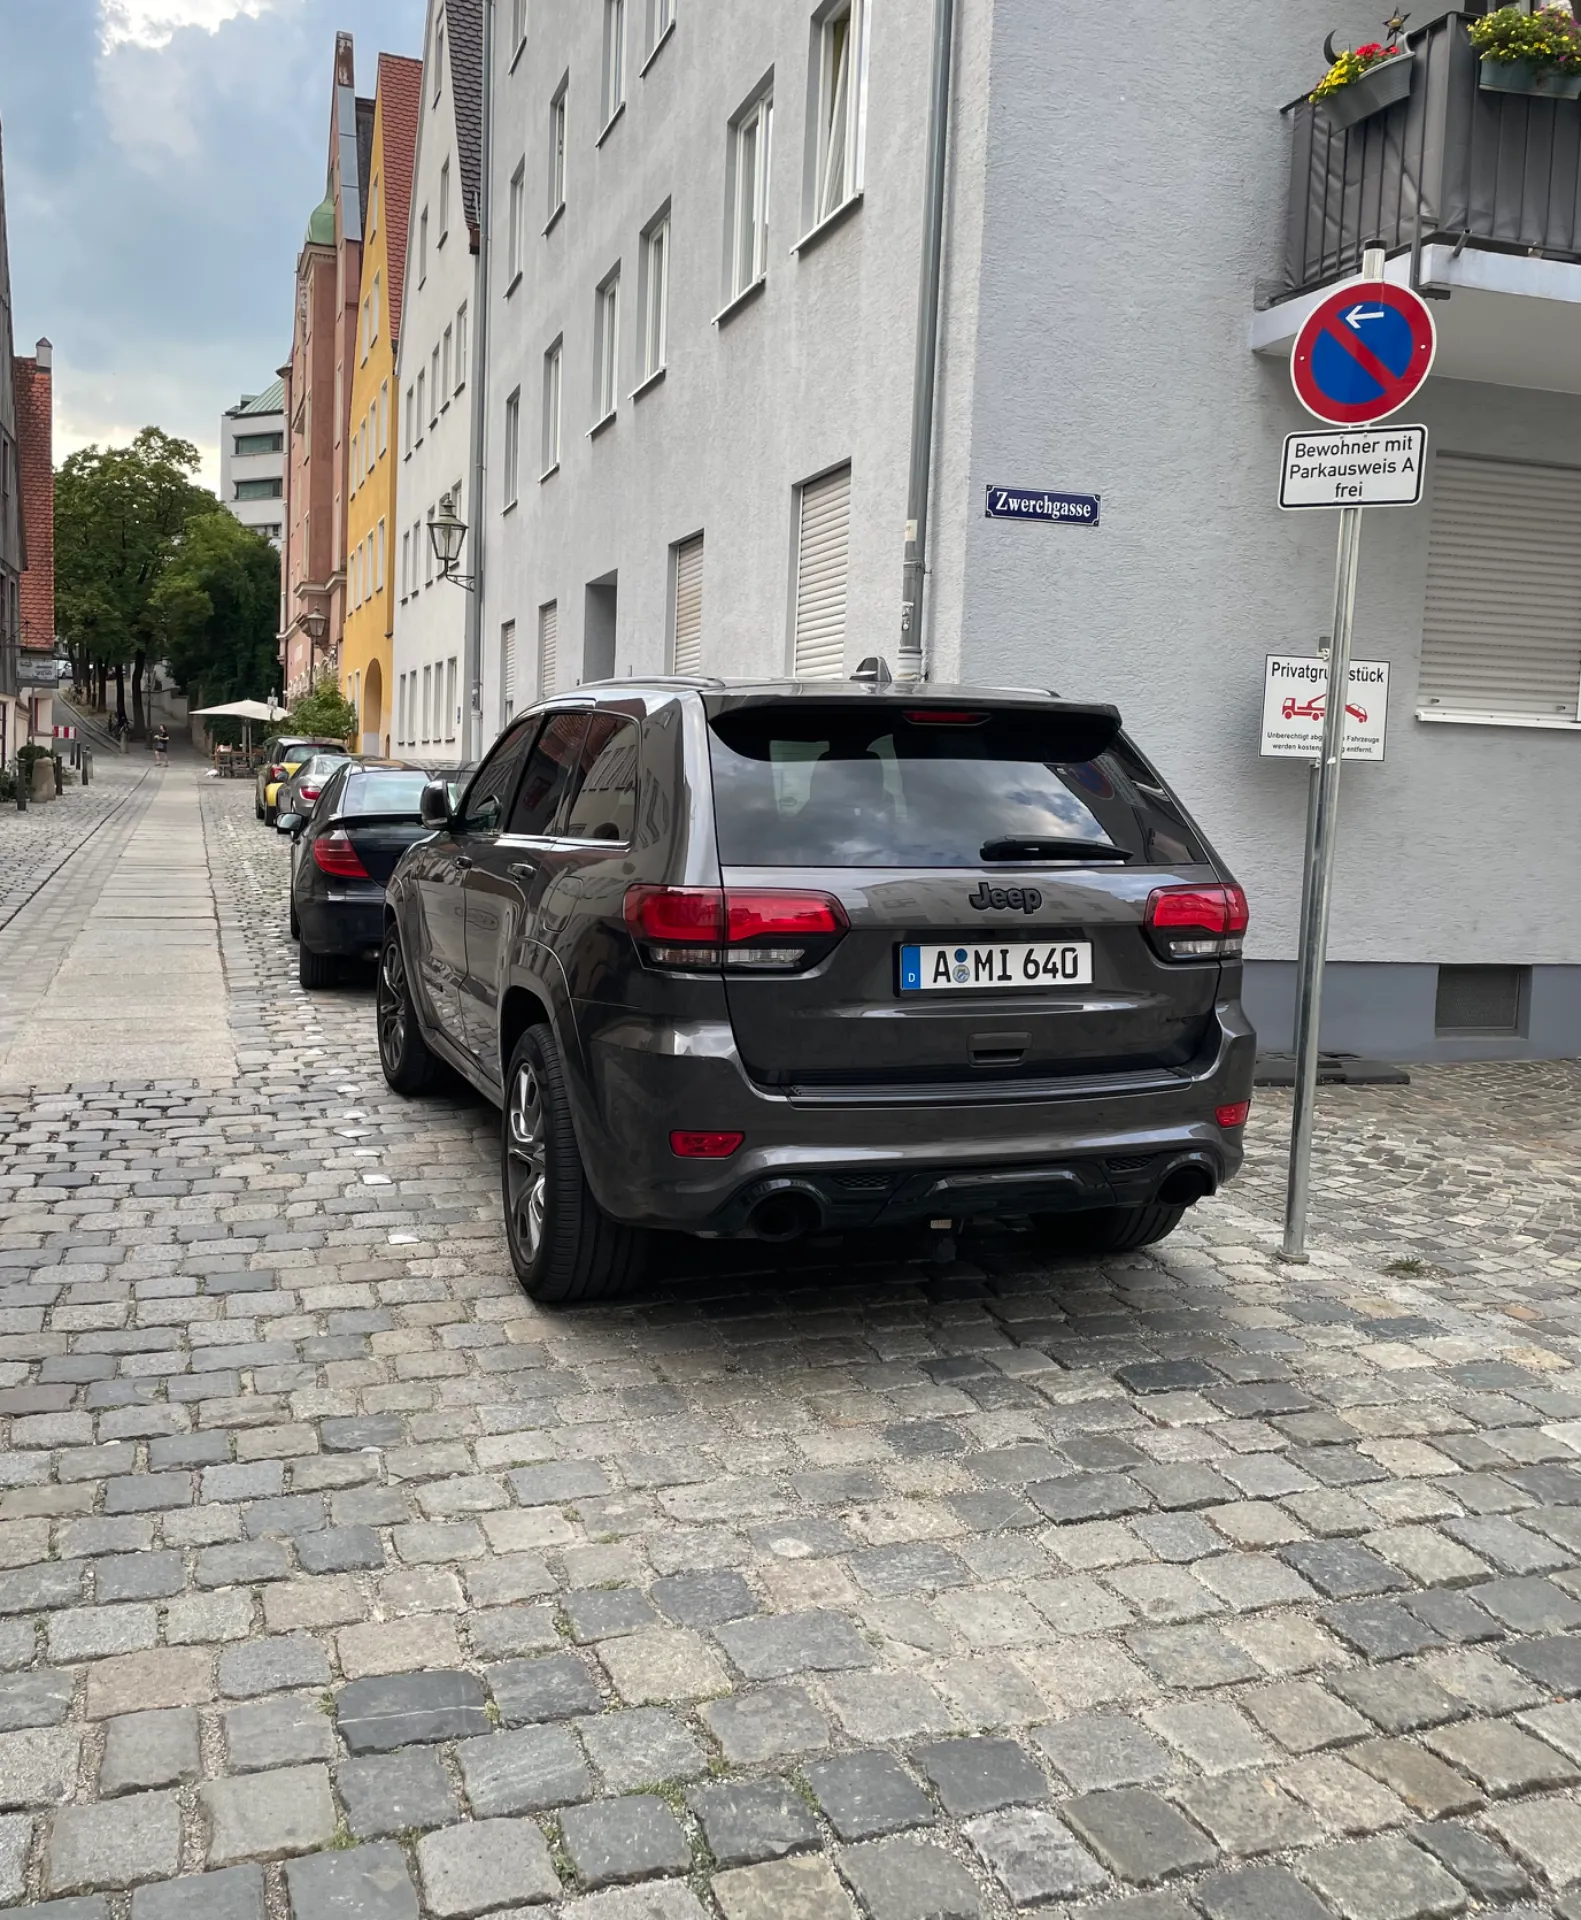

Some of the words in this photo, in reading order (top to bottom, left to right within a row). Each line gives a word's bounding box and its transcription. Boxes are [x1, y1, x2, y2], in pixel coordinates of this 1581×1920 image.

[1295, 439, 1381, 458] Bewohner
[1385, 435, 1413, 452] mit
[1289, 458, 1397, 479] Parkausweis
[1401, 457, 1415, 473] A
[1335, 481, 1363, 498] frei
[995, 491, 1091, 519] Zwerchgasse
[1271, 661, 1384, 683] Privatgrstück
[1267, 731, 1309, 741] Unberechtigt
[1346, 735, 1380, 744] Fahrzeuge
[968, 882, 1042, 914] Jeep
[932, 950, 951, 983] A
[974, 949, 1013, 982] MI
[1023, 947, 1079, 980] 640
[908, 973, 916, 983] D
